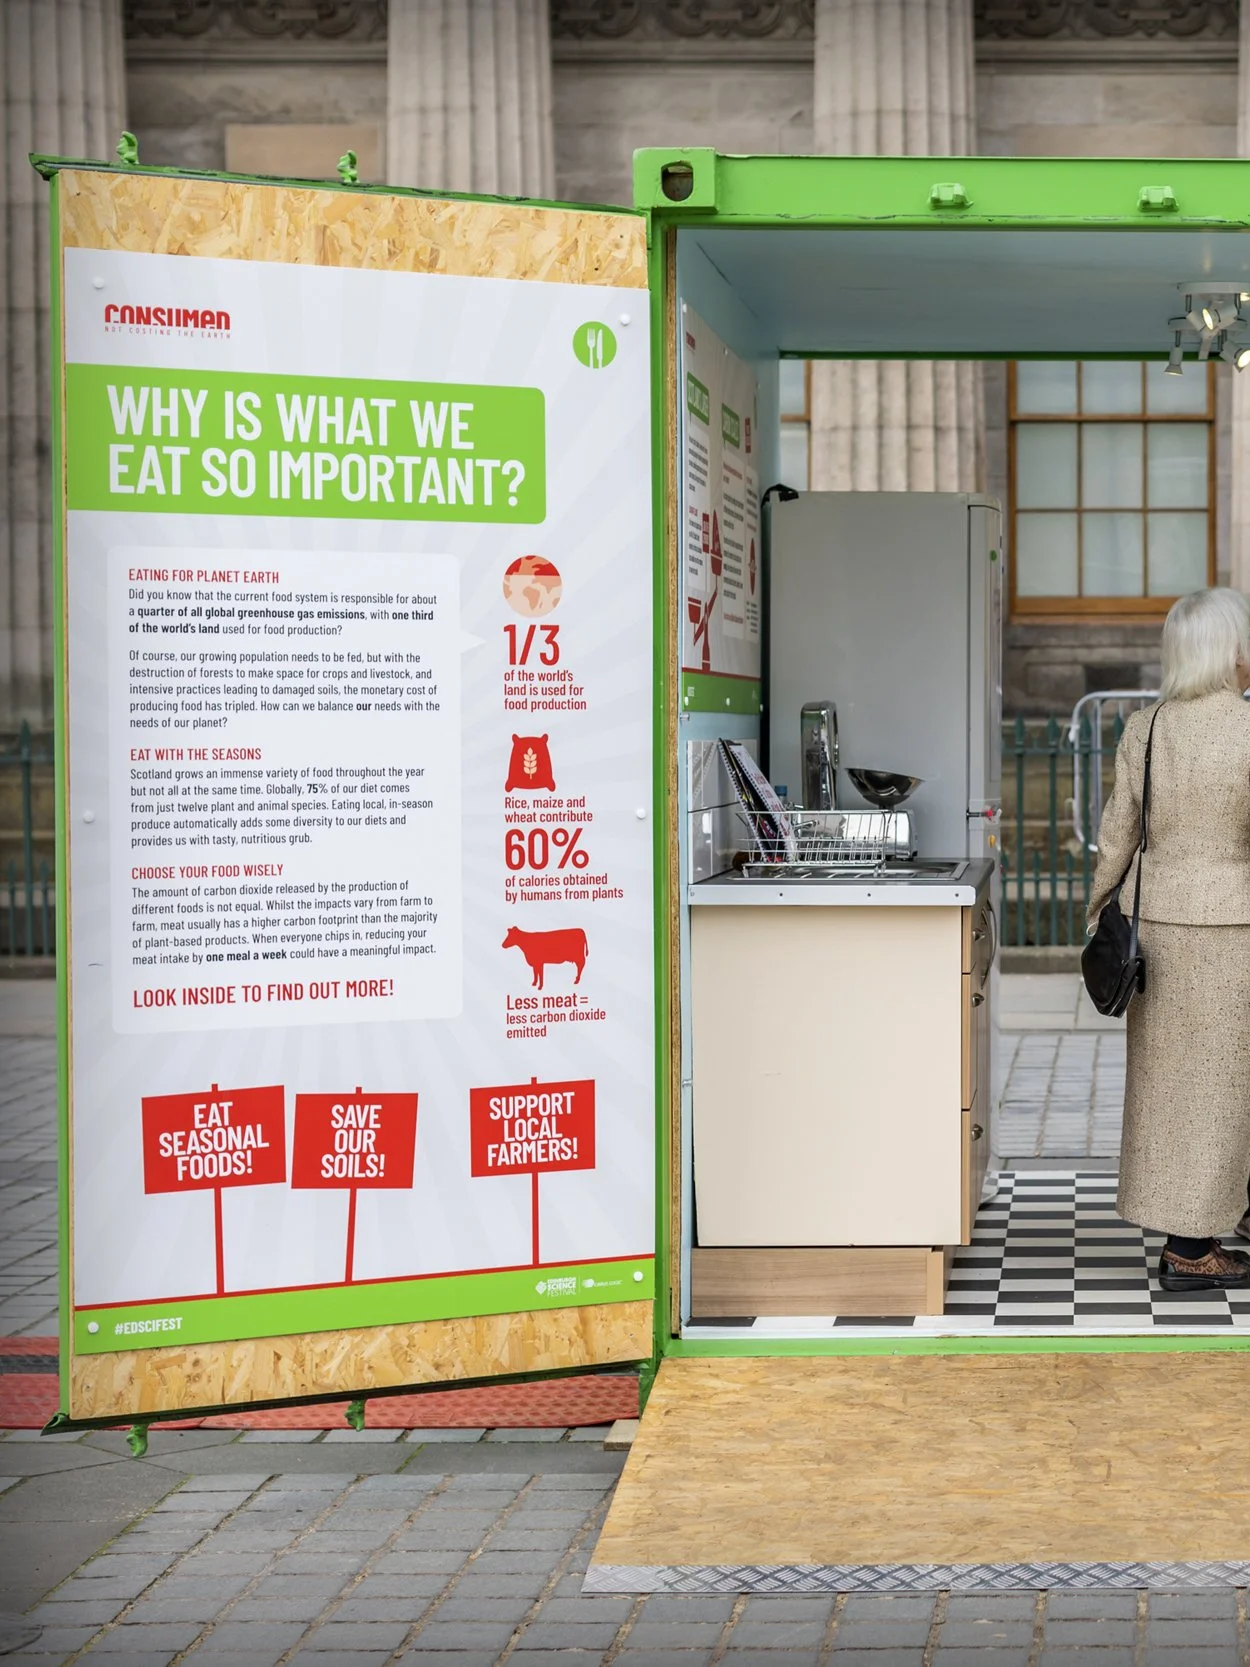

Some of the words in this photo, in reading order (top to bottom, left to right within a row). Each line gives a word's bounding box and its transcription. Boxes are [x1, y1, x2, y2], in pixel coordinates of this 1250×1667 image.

[129, 327, 171, 336] COSTING
[178, 330, 194, 338] THE
[201, 331, 231, 340] EARTH
[106, 386, 209, 438] WHY
[224, 391, 262, 442] IS
[275, 394, 397, 446] WHAT
[409, 400, 475, 451] WE
[109, 444, 191, 497] EAT
[201, 447, 256, 500] SO
[268, 451, 526, 507] IMPORTANT?
[128, 568, 169, 581] EATING
[172, 569, 194, 582] FOR
[197, 570, 240, 582] PLANET
[243, 571, 279, 583] EARTH
[128, 588, 144, 600] Did
[146, 591, 164, 602] you
[166, 589, 192, 600] know
[194, 590, 214, 601] that
[216, 590, 232, 601] the
[234, 592, 269, 601] current
[271, 591, 293, 602] food
[295, 593, 328, 604] system
[330, 592, 339, 603] is
[341, 593, 394, 605] responsible
[396, 593, 409, 604] for
[411, 594, 437, 604] about
[503, 624, 560, 666] 1/3
[504, 670, 515, 681] of
[517, 670, 535, 682] the
[537, 669, 574, 682] world's
[504, 684, 527, 696] land
[529, 684, 539, 696] is
[541, 684, 566, 696] used
[569, 683, 584, 696] for
[504, 698, 528, 710] food
[530, 698, 587, 712] production
[130, 748, 151, 761] EAT
[154, 748, 184, 760] WITH
[187, 748, 208, 760] THE
[212, 748, 262, 760] SEASONS
[504, 796, 530, 810] Rice,
[532, 796, 564, 808] maize
[566, 796, 585, 808] and
[504, 811, 537, 823] wheat
[539, 810, 593, 822] contribute
[505, 827, 590, 871] 60%
[131, 866, 175, 880] CHOOSE
[179, 865, 208, 878] YOUR
[211, 865, 240, 877] FOOD
[243, 864, 283, 876] WISELY
[505, 875, 516, 888] of
[518, 874, 560, 887] calories
[562, 873, 608, 886] obtained
[505, 890, 518, 905] by
[520, 889, 562, 901] humans
[564, 888, 589, 900] from
[592, 887, 624, 901] plants
[133, 989, 177, 1009] LOOK
[182, 986, 236, 1006] INSIDE
[241, 984, 262, 1004] TO
[267, 983, 304, 1002] FIND
[309, 981, 341, 1000] OUT
[346, 979, 393, 998] MORE!
[506, 995, 539, 1010] Less
[542, 993, 578, 1008] meat
[506, 1013, 528, 1025] less
[530, 1011, 566, 1023] carbon
[569, 1008, 606, 1021] dioxide
[506, 1025, 547, 1039] emitted
[194, 1102, 233, 1128] EAT
[489, 1092, 575, 1121] SUPPORT
[331, 1104, 381, 1129] SAVE
[504, 1117, 562, 1142] LOCAL
[159, 1125, 269, 1157] SEASONAL
[334, 1129, 375, 1154] OUR
[487, 1139, 578, 1167] FARMERS!
[177, 1151, 252, 1181] FOODS!
[321, 1153, 385, 1178] SOILS!
[547, 1281, 576, 1289] SCIENCE
[547, 1289, 576, 1297] FESTIVAL
[114, 1317, 183, 1334] #EDSCIFEST
